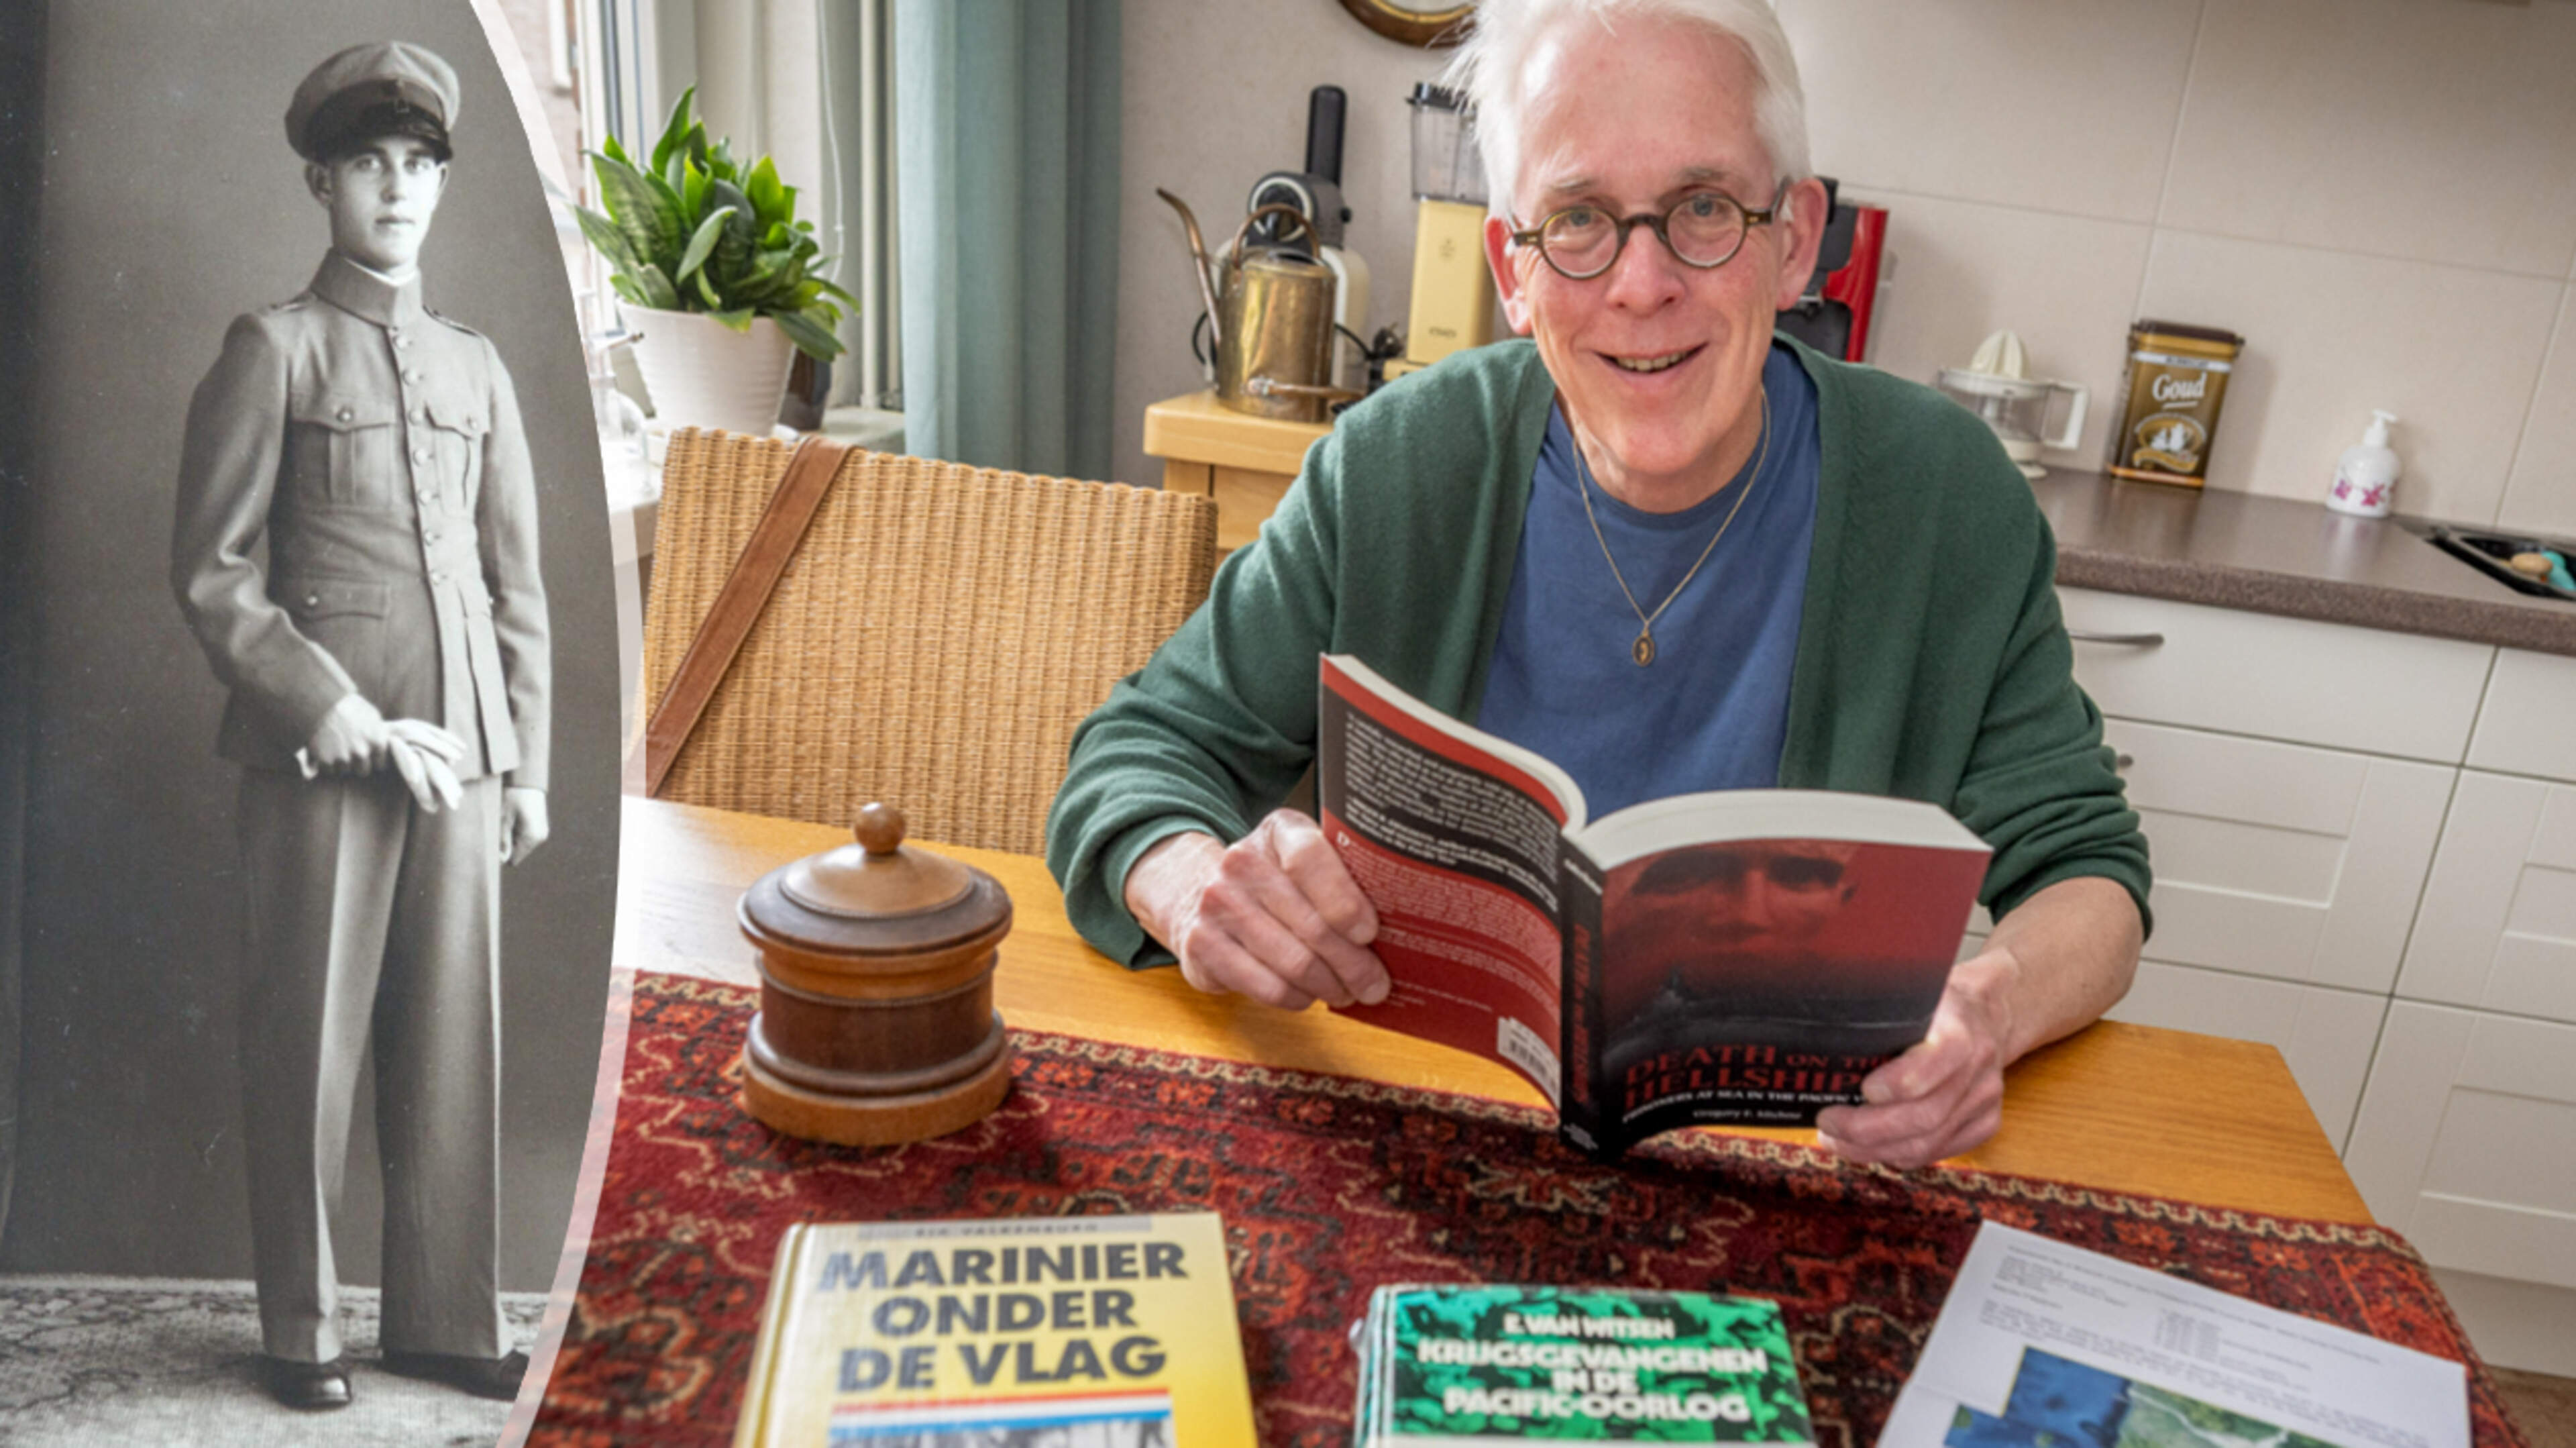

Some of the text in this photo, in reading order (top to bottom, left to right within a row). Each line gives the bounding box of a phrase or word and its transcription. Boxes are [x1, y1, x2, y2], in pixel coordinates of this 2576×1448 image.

[2152, 370, 2208, 401] Goud
[1626, 1044, 1776, 1086] DEATH
[1786, 1055, 1829, 1069] ON
[1625, 1066, 1864, 1111] HELLSHIP
[1697, 1090, 1714, 1100] AT
[1717, 1090, 1744, 1100] SEA
[1747, 1091, 1764, 1101] IN
[1768, 1092, 1795, 1102] THE
[819, 1242, 1189, 1290] MARINIER
[873, 1290, 1138, 1337] ONDER
[1523, 1313, 1580, 1337] VAN
[1581, 1315, 1676, 1341] WITSEN
[836, 1335, 1167, 1394] DE VLAG
[1417, 1337, 1770, 1374] KRIJGSGEVANGENEN
[1551, 1370, 1638, 1396] IN DE
[1442, 1386, 1752, 1422] PACIFIC-OORLOG
